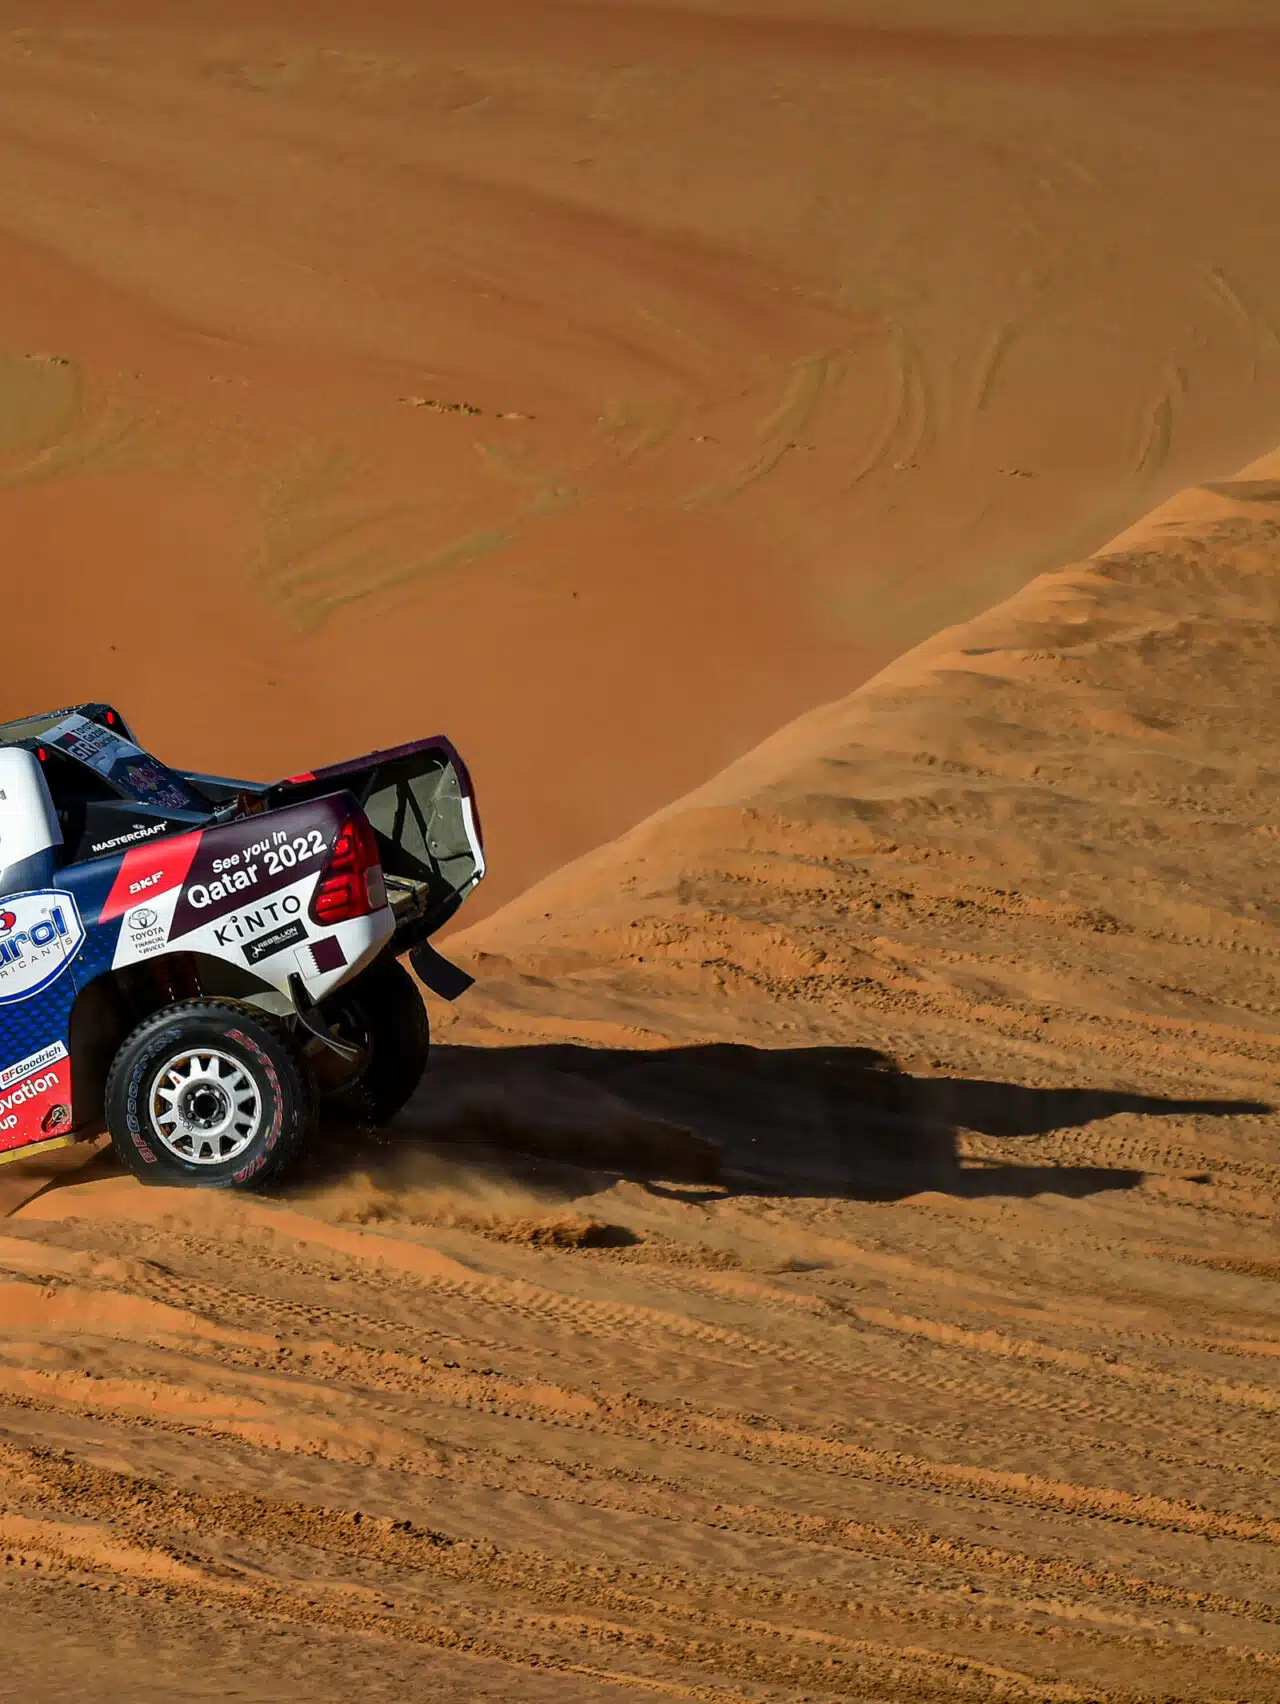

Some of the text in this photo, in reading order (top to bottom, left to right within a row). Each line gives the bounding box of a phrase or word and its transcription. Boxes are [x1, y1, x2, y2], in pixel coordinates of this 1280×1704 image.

[91, 822, 167, 852] MASTERCRAFT
[212, 830, 288, 873] See you in
[129, 871, 164, 894] SKF
[187, 830, 328, 909] Qatar 2022
[130, 926, 164, 941] TOYOTA
[1, 1045, 61, 1082] BFGoodrich
